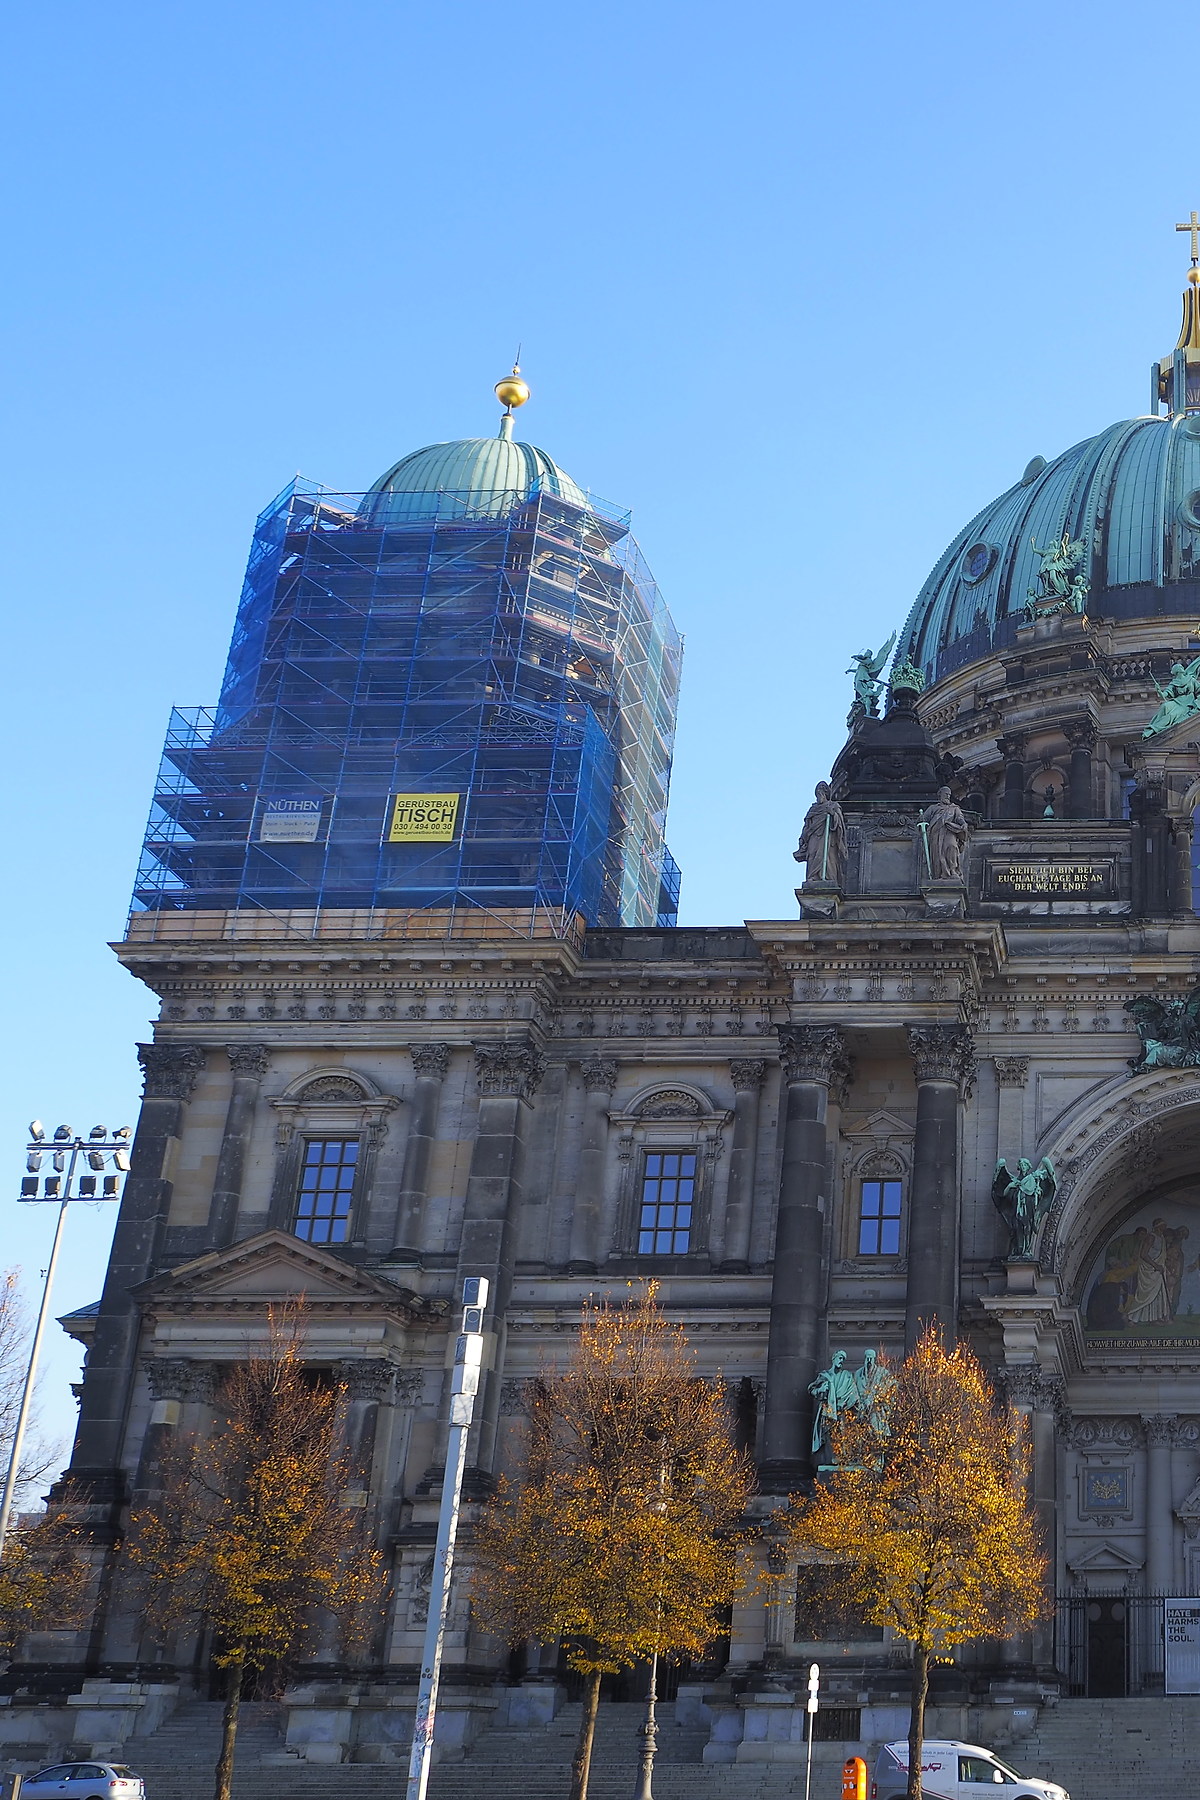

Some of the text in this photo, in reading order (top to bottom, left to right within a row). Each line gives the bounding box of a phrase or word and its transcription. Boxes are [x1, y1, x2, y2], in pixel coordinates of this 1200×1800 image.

[267, 799, 320, 811] NÜTHEN
[398, 800, 456, 808] GERÜSTBAU
[397, 808, 454, 822] TISCH
[1009, 866, 1093, 874] SIEHE, ICH BIN BEI
[998, 875, 1103, 883] EUCH ALLE TAGE BIS AN
[1014, 883, 1090, 891] DER WELT ENDE.
